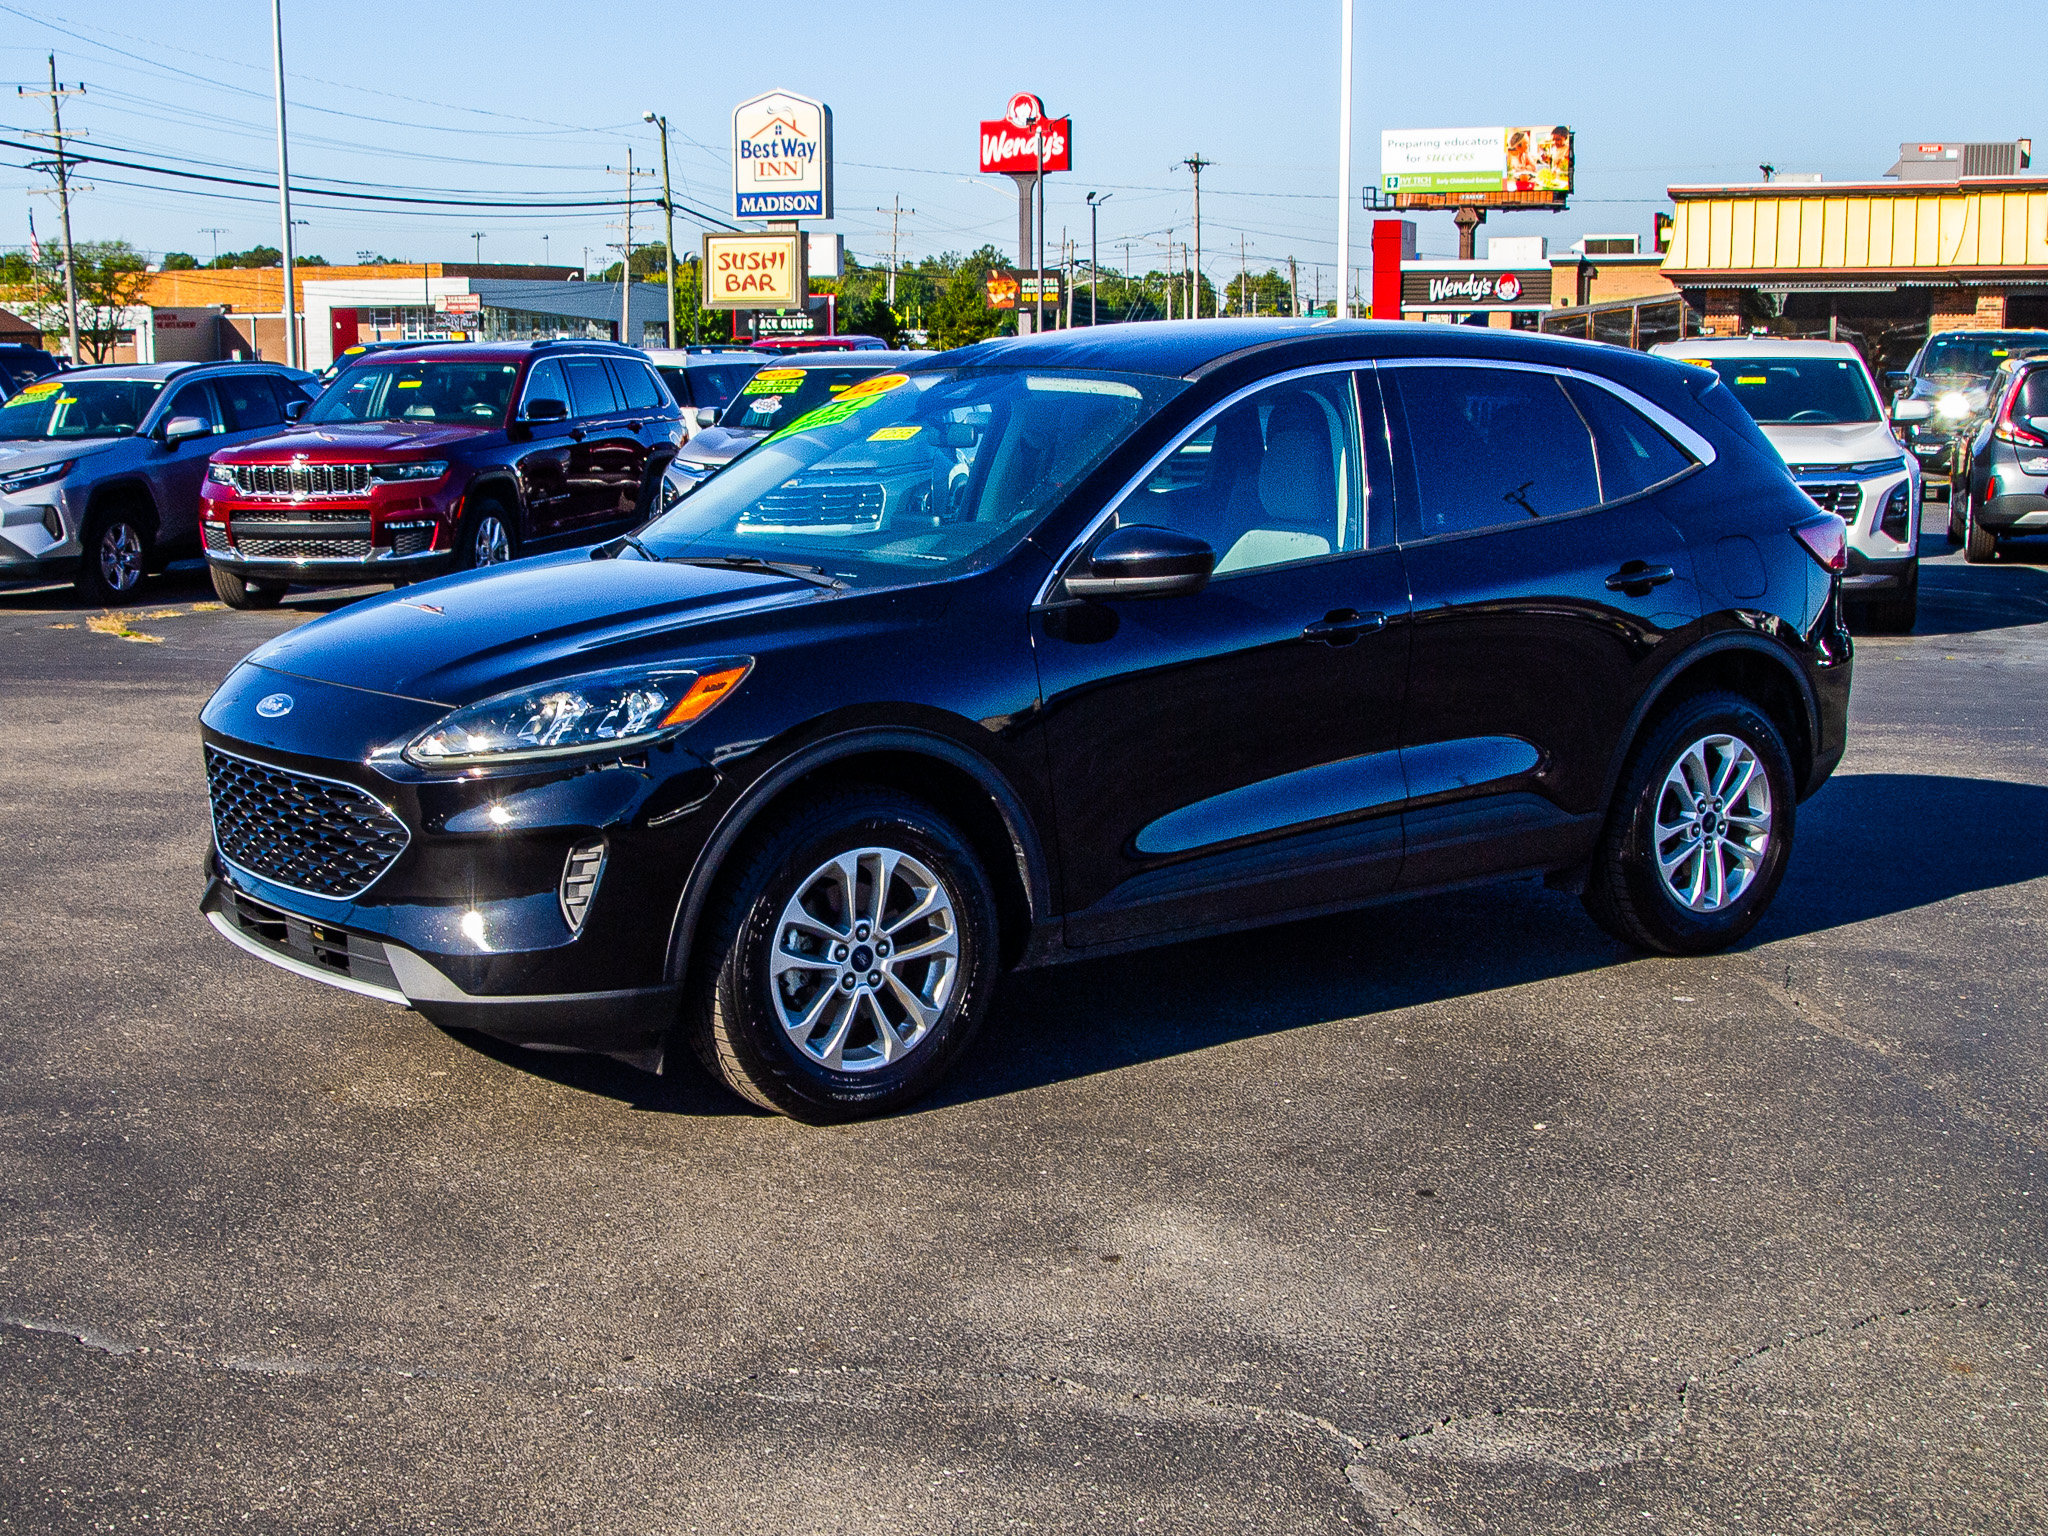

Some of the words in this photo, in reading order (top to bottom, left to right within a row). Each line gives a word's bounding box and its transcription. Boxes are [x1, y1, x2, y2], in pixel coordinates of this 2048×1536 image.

[741, 138, 779, 159] Best
[780, 137, 817, 164] Way
[982, 127, 1065, 166] Wendy's
[1388, 139, 1440, 150] Preparing
[1444, 137, 1499, 147] educators
[1406, 153, 1421, 163] for
[1426, 152, 1475, 163] success
[759, 161, 798, 176] INN
[740, 195, 818, 213] MADISON
[717, 251, 785, 271] SUSHI
[725, 273, 777, 292] BAR
[1429, 273, 1493, 302] Wendy's
[780, 318, 814, 330] OLIVES
